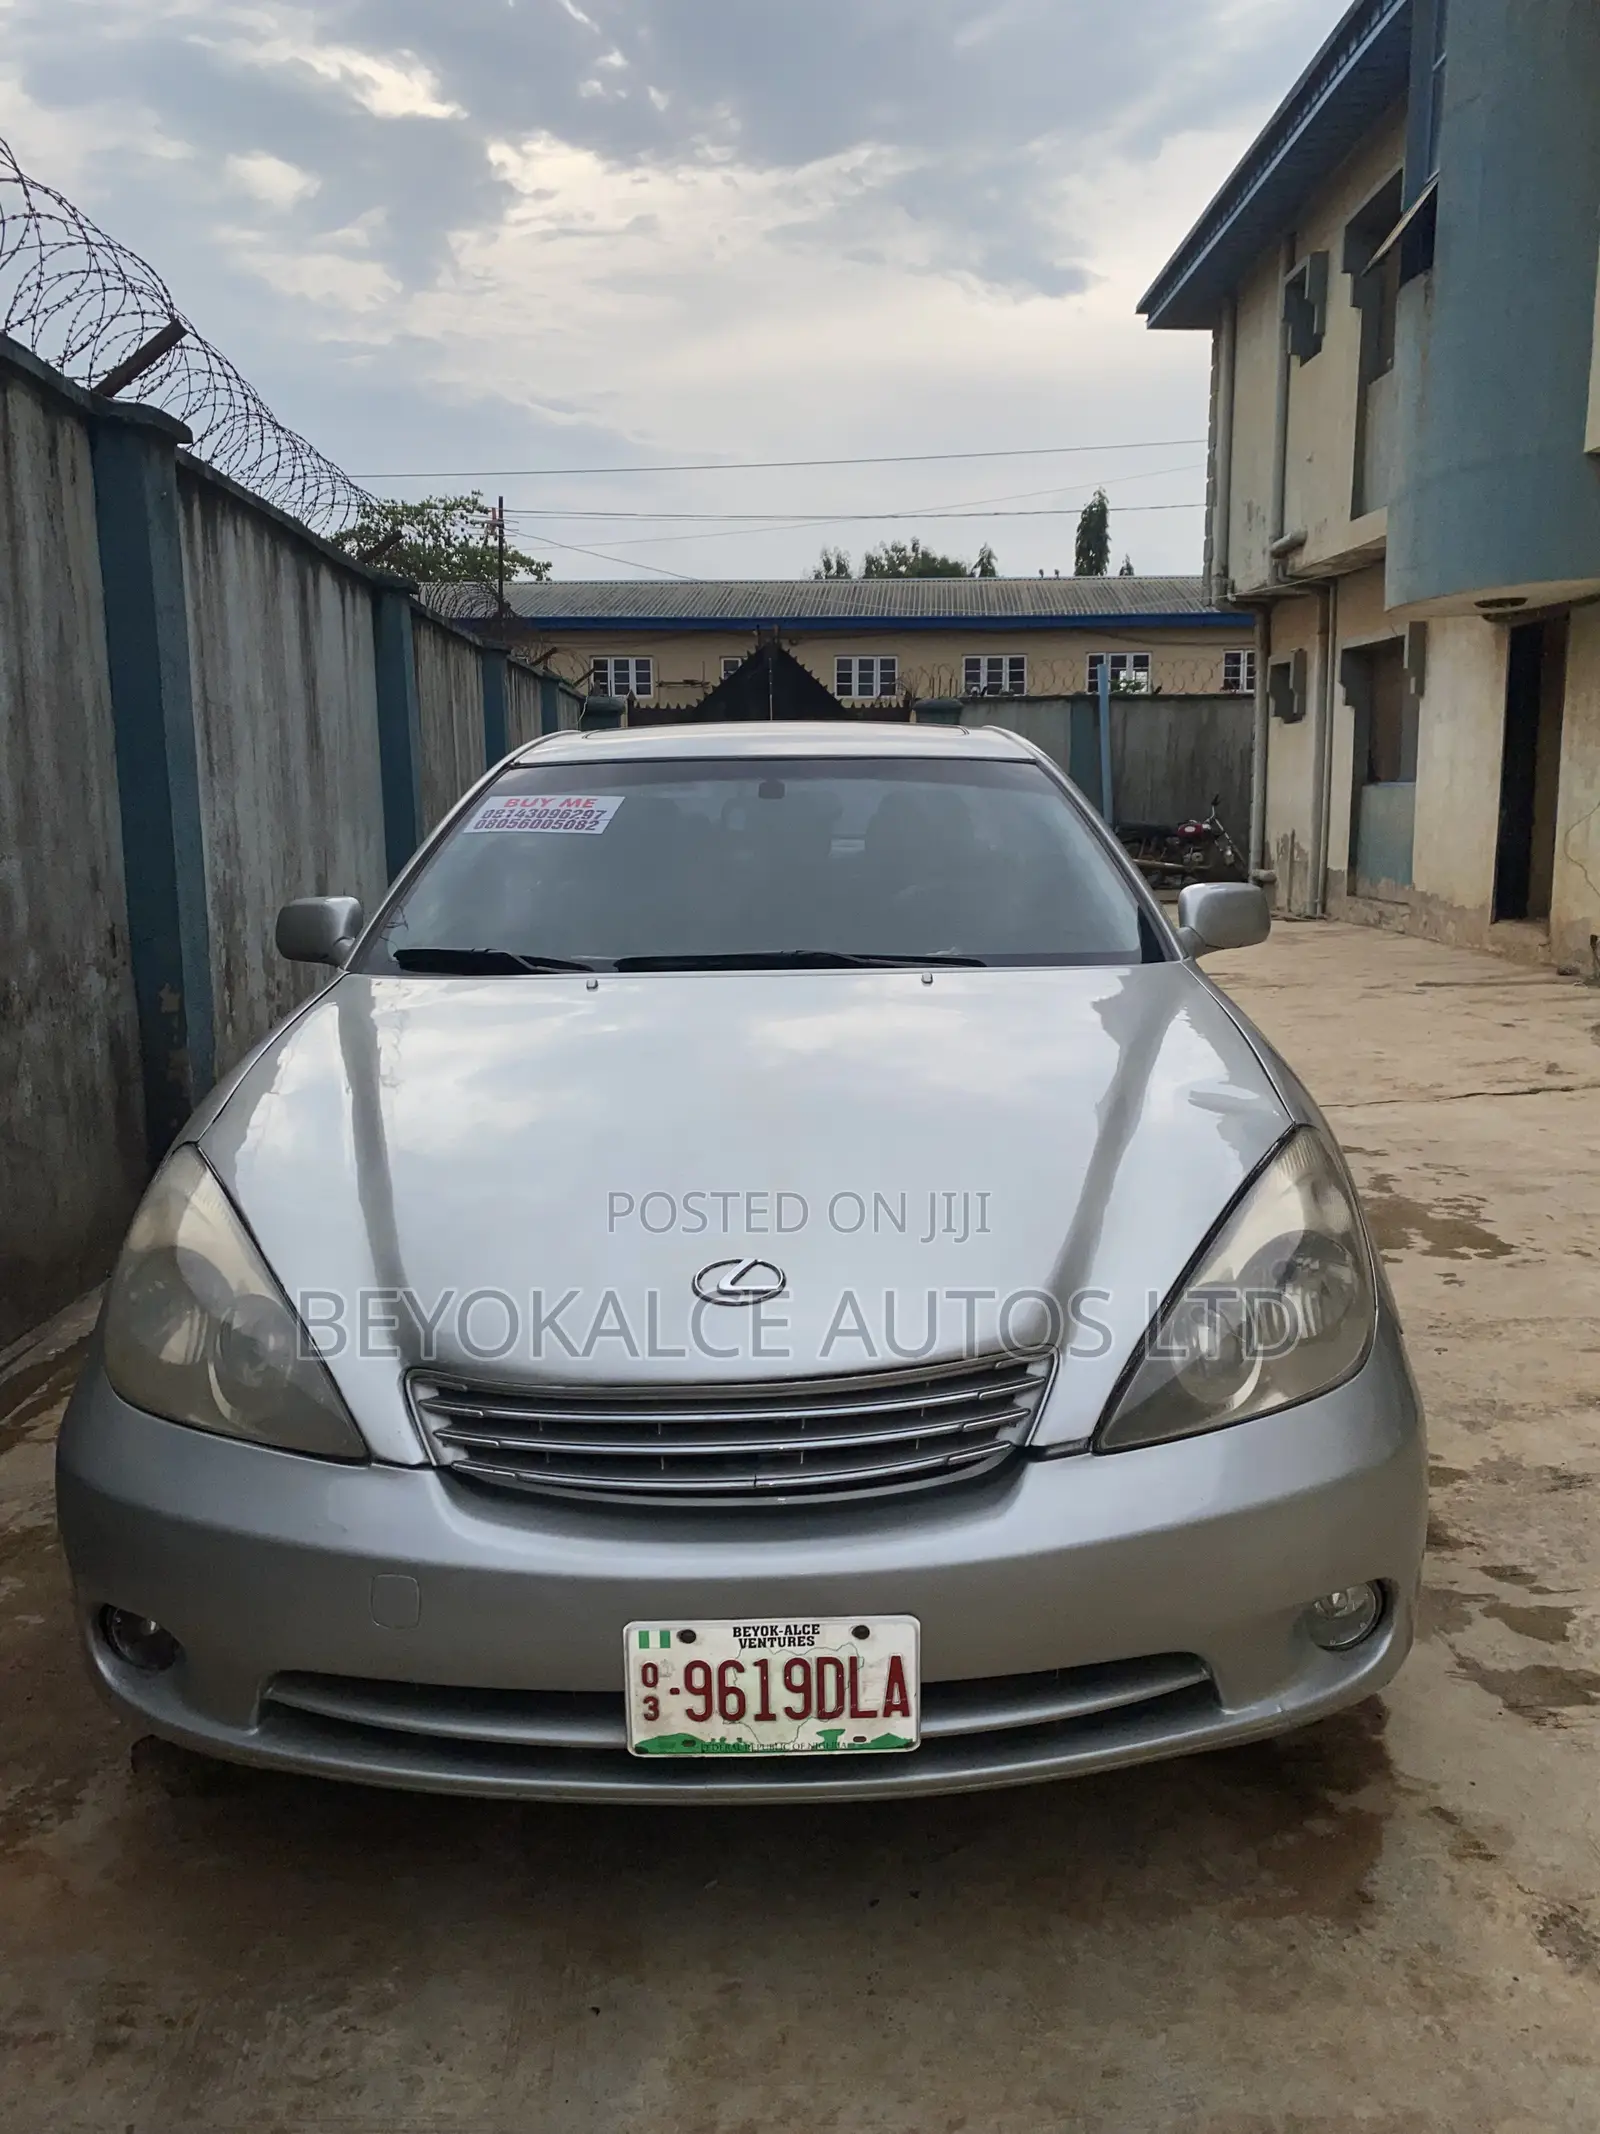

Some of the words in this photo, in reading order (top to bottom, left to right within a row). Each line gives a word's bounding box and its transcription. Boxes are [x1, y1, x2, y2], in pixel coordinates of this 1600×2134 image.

[504, 797, 556, 808] BUY
[559, 798, 599, 808] ME
[473, 818, 600, 831] 08056005082
[732, 1624, 820, 1638] BEYOK-ALCE
[738, 1636, 815, 1649] VENTURES
